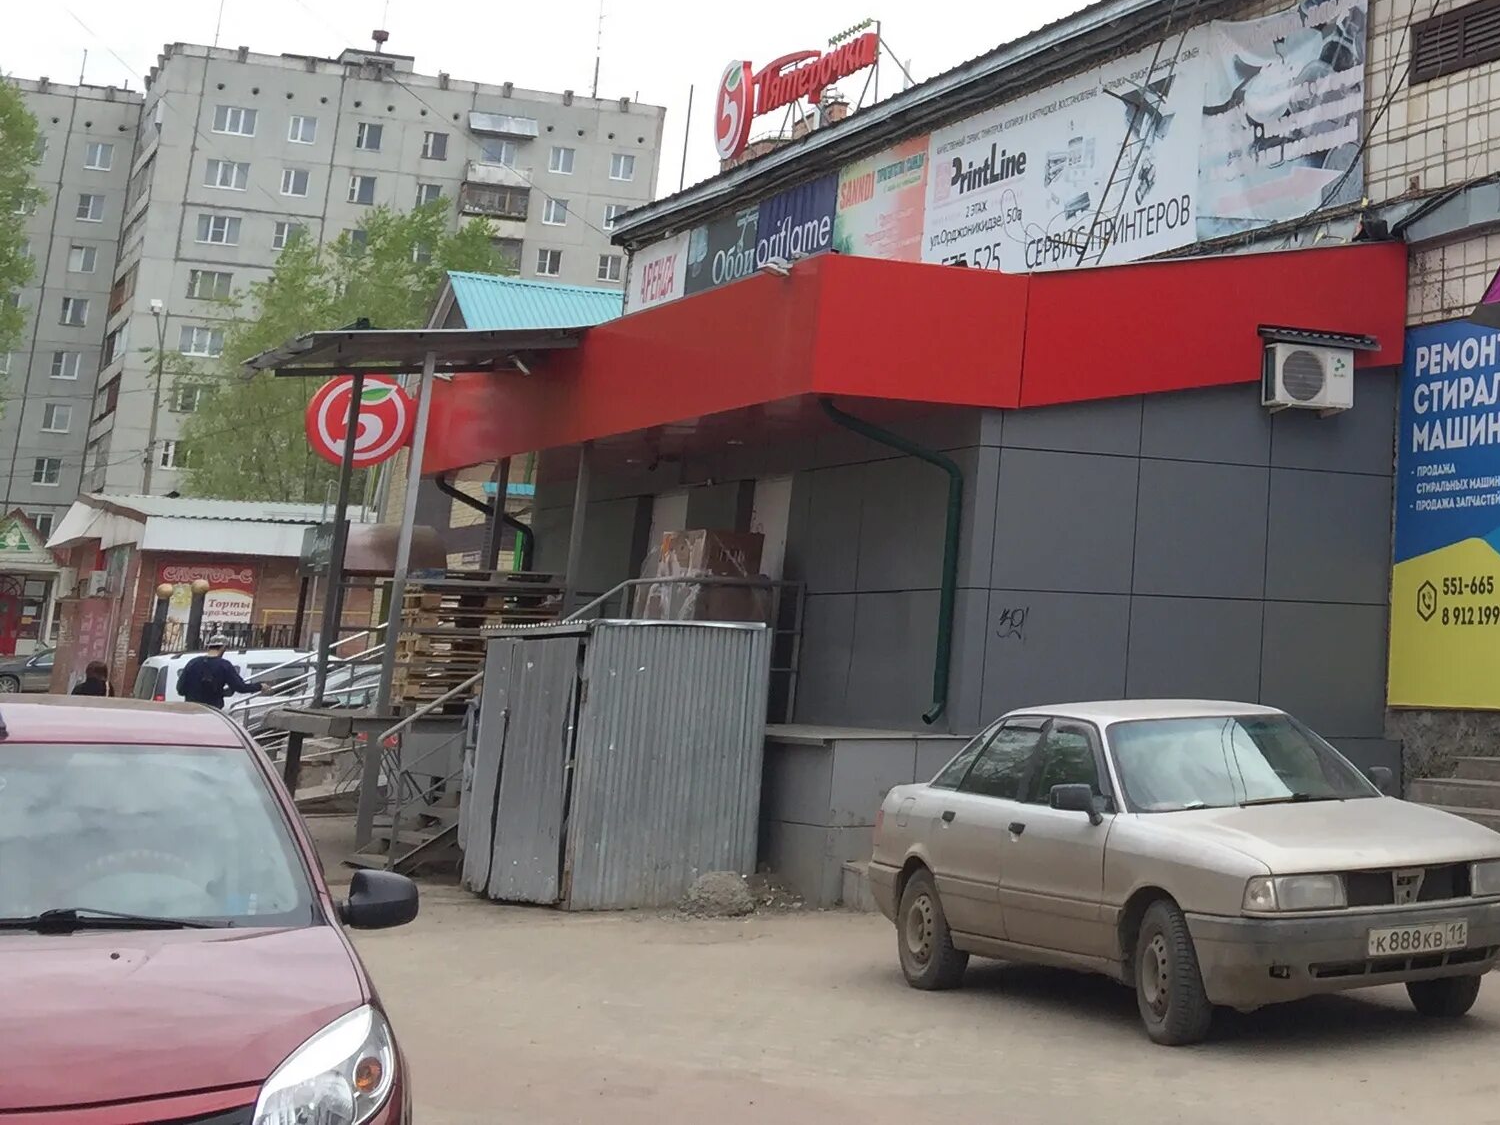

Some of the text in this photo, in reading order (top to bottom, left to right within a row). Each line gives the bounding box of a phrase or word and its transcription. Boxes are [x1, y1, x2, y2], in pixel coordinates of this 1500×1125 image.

[950, 143, 1027, 194] PrintLine
[965, 202, 988, 218] 2 ЭТАЖ
[1006, 206, 1023, 225] 50а
[1025, 194, 1191, 269] СЕРВИС ПРИНТЕРОВ
[756, 215, 831, 268] oriflame
[712, 245, 755, 285] Обои
[640, 254, 676, 304] АРЕНДА
[1416, 463, 1456, 477] ПРОДАЖА
[1416, 475, 1500, 494] СТИРАЛЬНЫХ МАШИН
[1415, 497, 1455, 511] ПРОДАЖА
[1442, 576, 1494, 595] 551-665
[208, 598, 251, 611] Торты
[1442, 607, 1450, 625] 8
[1453, 606, 1474, 625] 912
